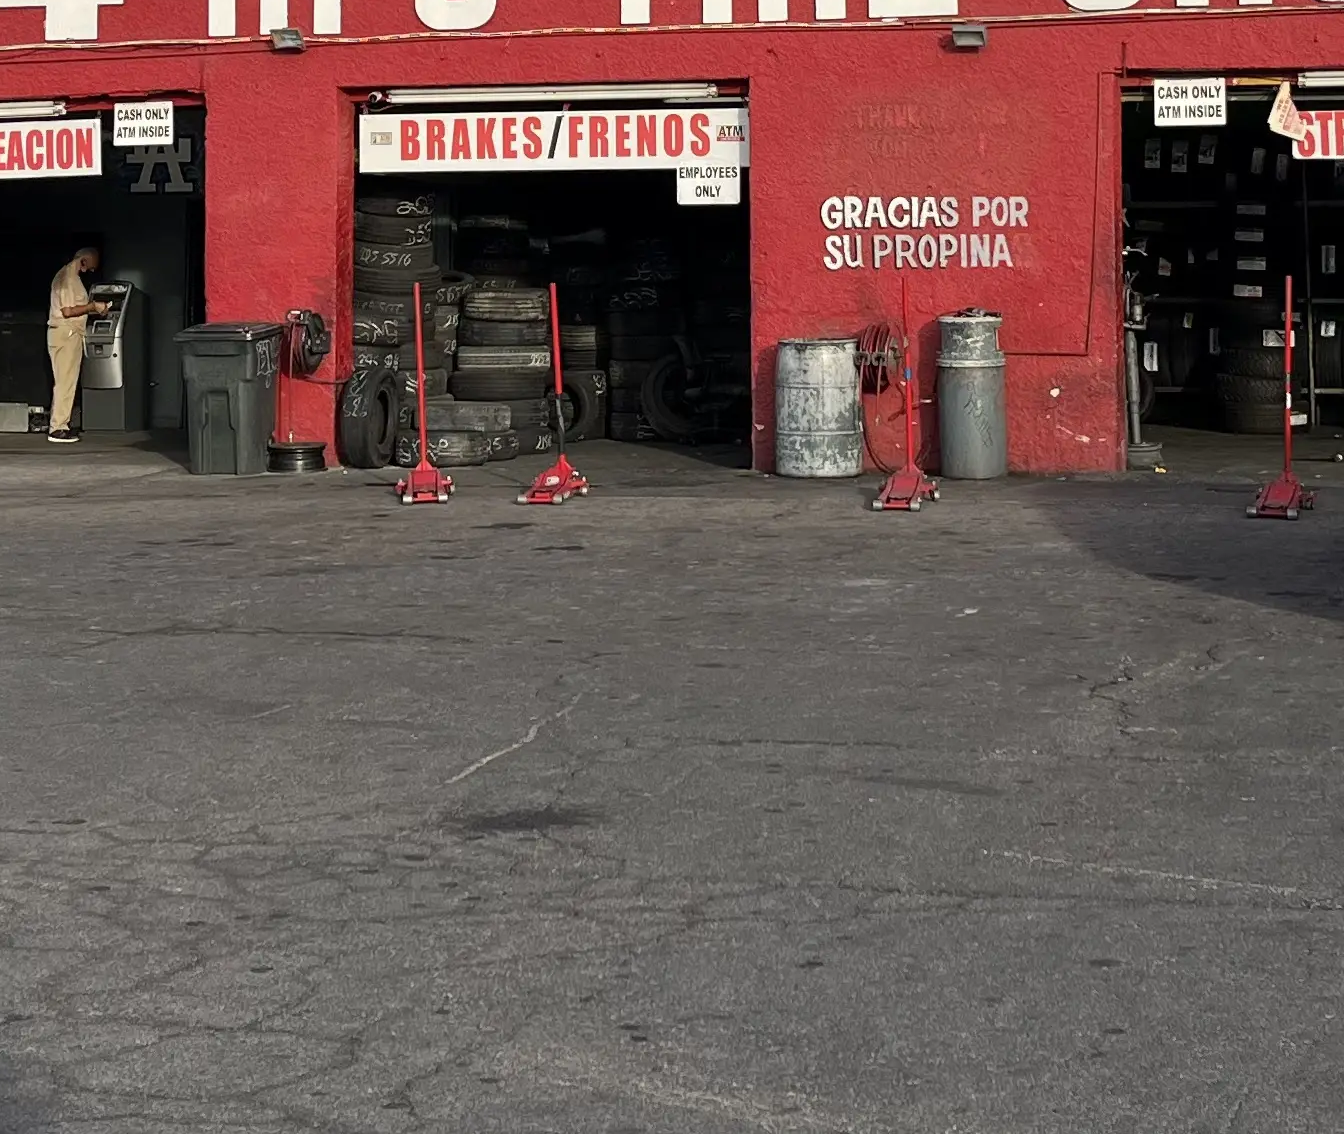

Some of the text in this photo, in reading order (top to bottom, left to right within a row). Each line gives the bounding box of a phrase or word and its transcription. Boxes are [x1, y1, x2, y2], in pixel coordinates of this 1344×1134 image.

[1158, 86, 1222, 99] CASH ONLY
[118, 108, 170, 121] CASH ONLY
[1158, 105, 1223, 118] ATM INSIDE
[117, 126, 170, 138] ATM INSIDE
[718, 125, 744, 137] ATM
[679, 166, 738, 179] EMPLOYEES
[695, 185, 722, 197] ONLY
[820, 195, 1029, 230] GRACIAS POR
[823, 233, 1014, 270] SU PROPINA
